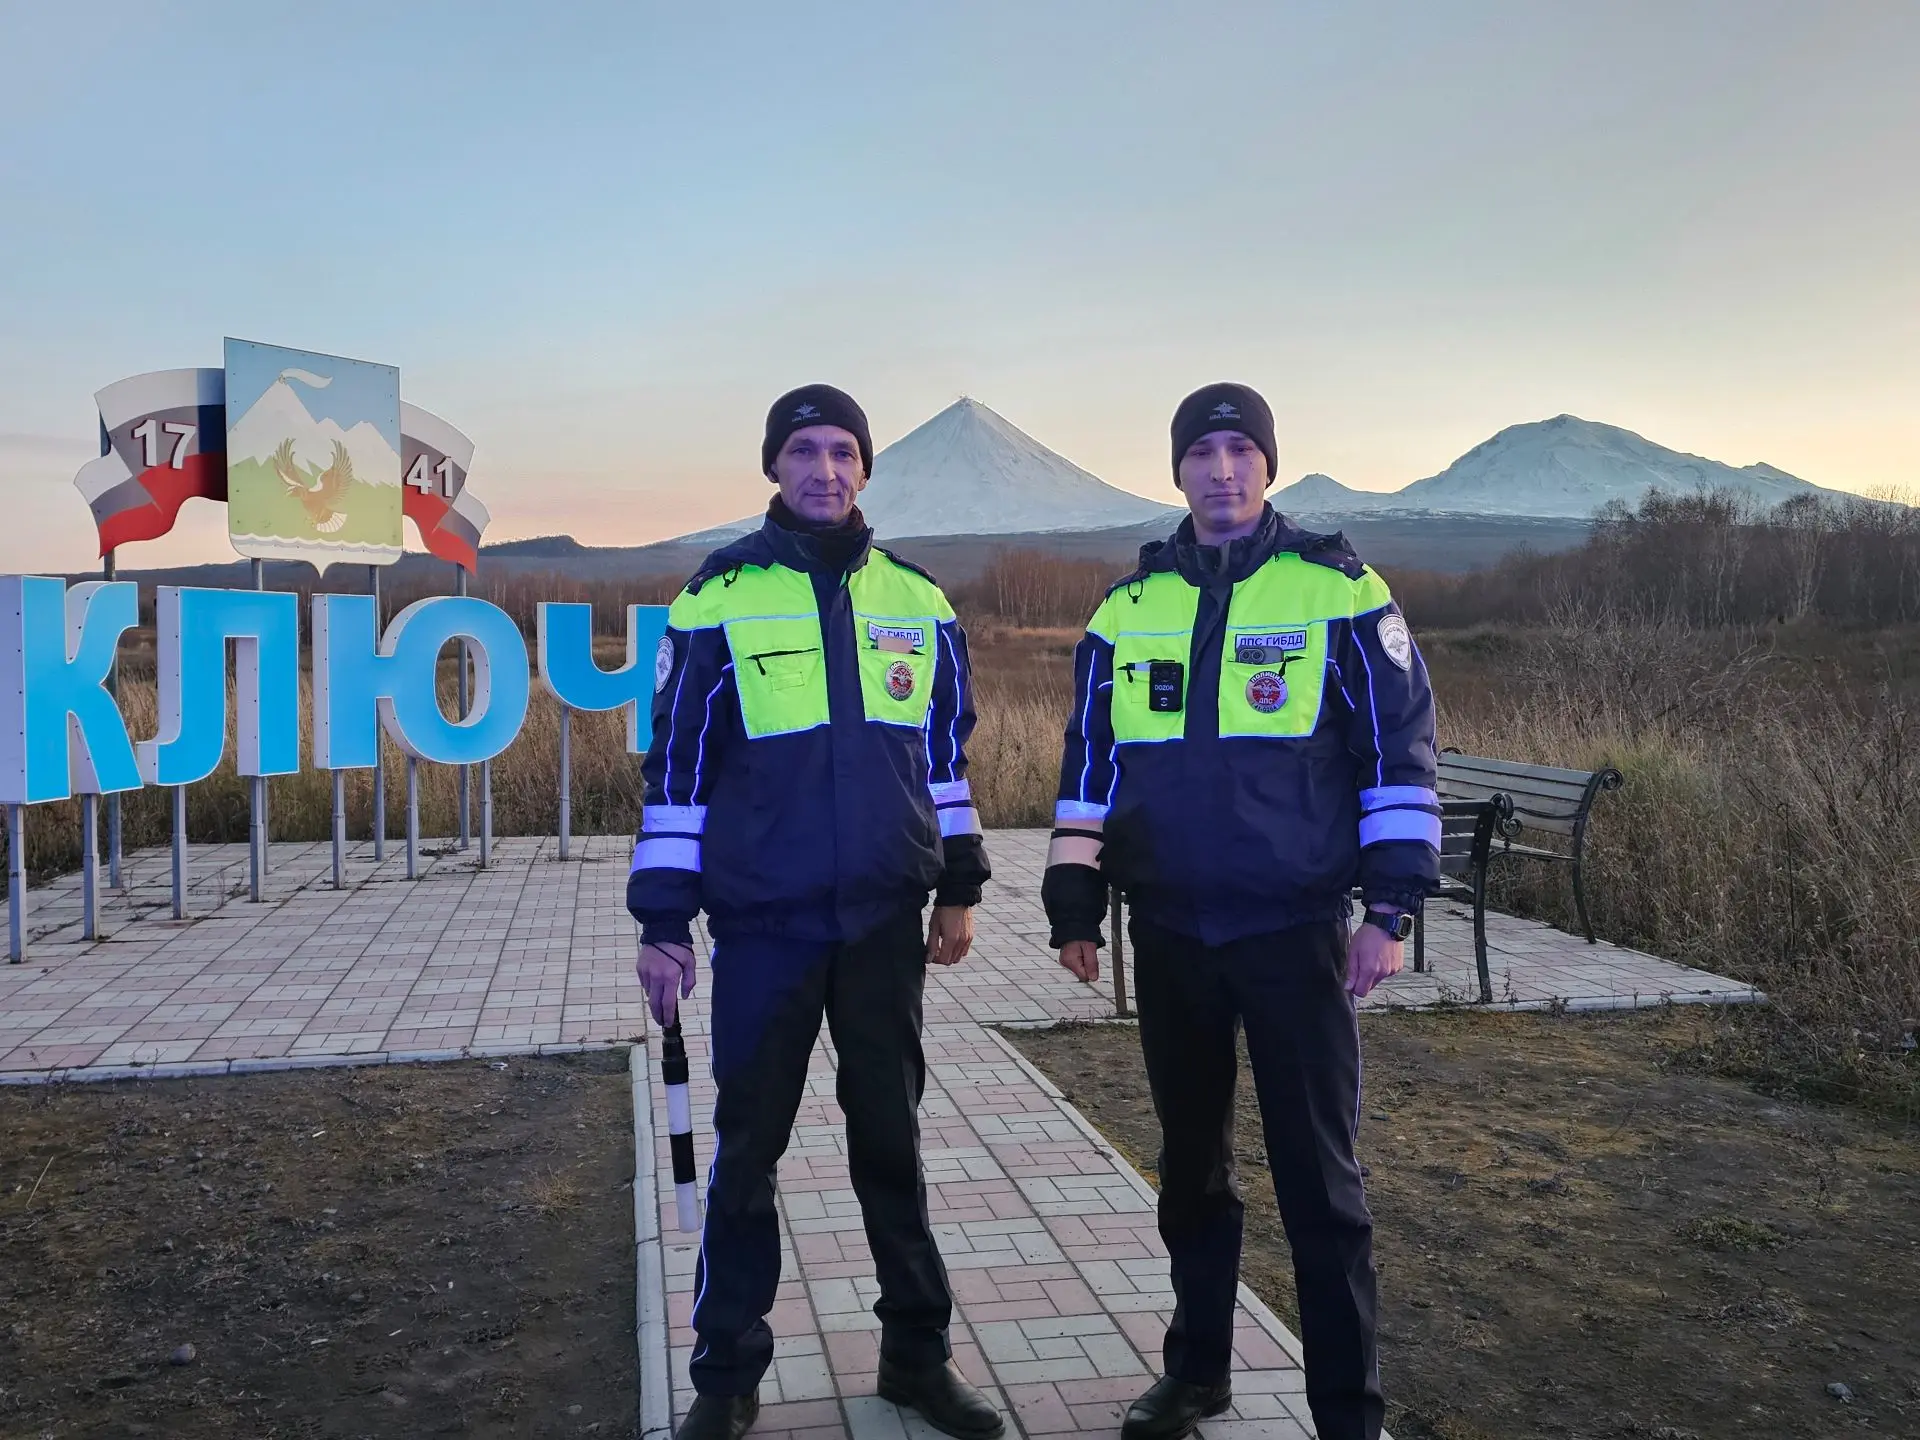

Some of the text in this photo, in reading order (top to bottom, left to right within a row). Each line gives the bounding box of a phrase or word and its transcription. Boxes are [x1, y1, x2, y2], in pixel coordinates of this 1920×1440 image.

[131, 418, 197, 470] 17
[403, 452, 454, 498] 41
[1240, 634, 1304, 647] ДПС ГИБДД
[0, 574, 671, 804] КЛЮЧ
[1251, 672, 1284, 685] ПОЛИЦИЯ
